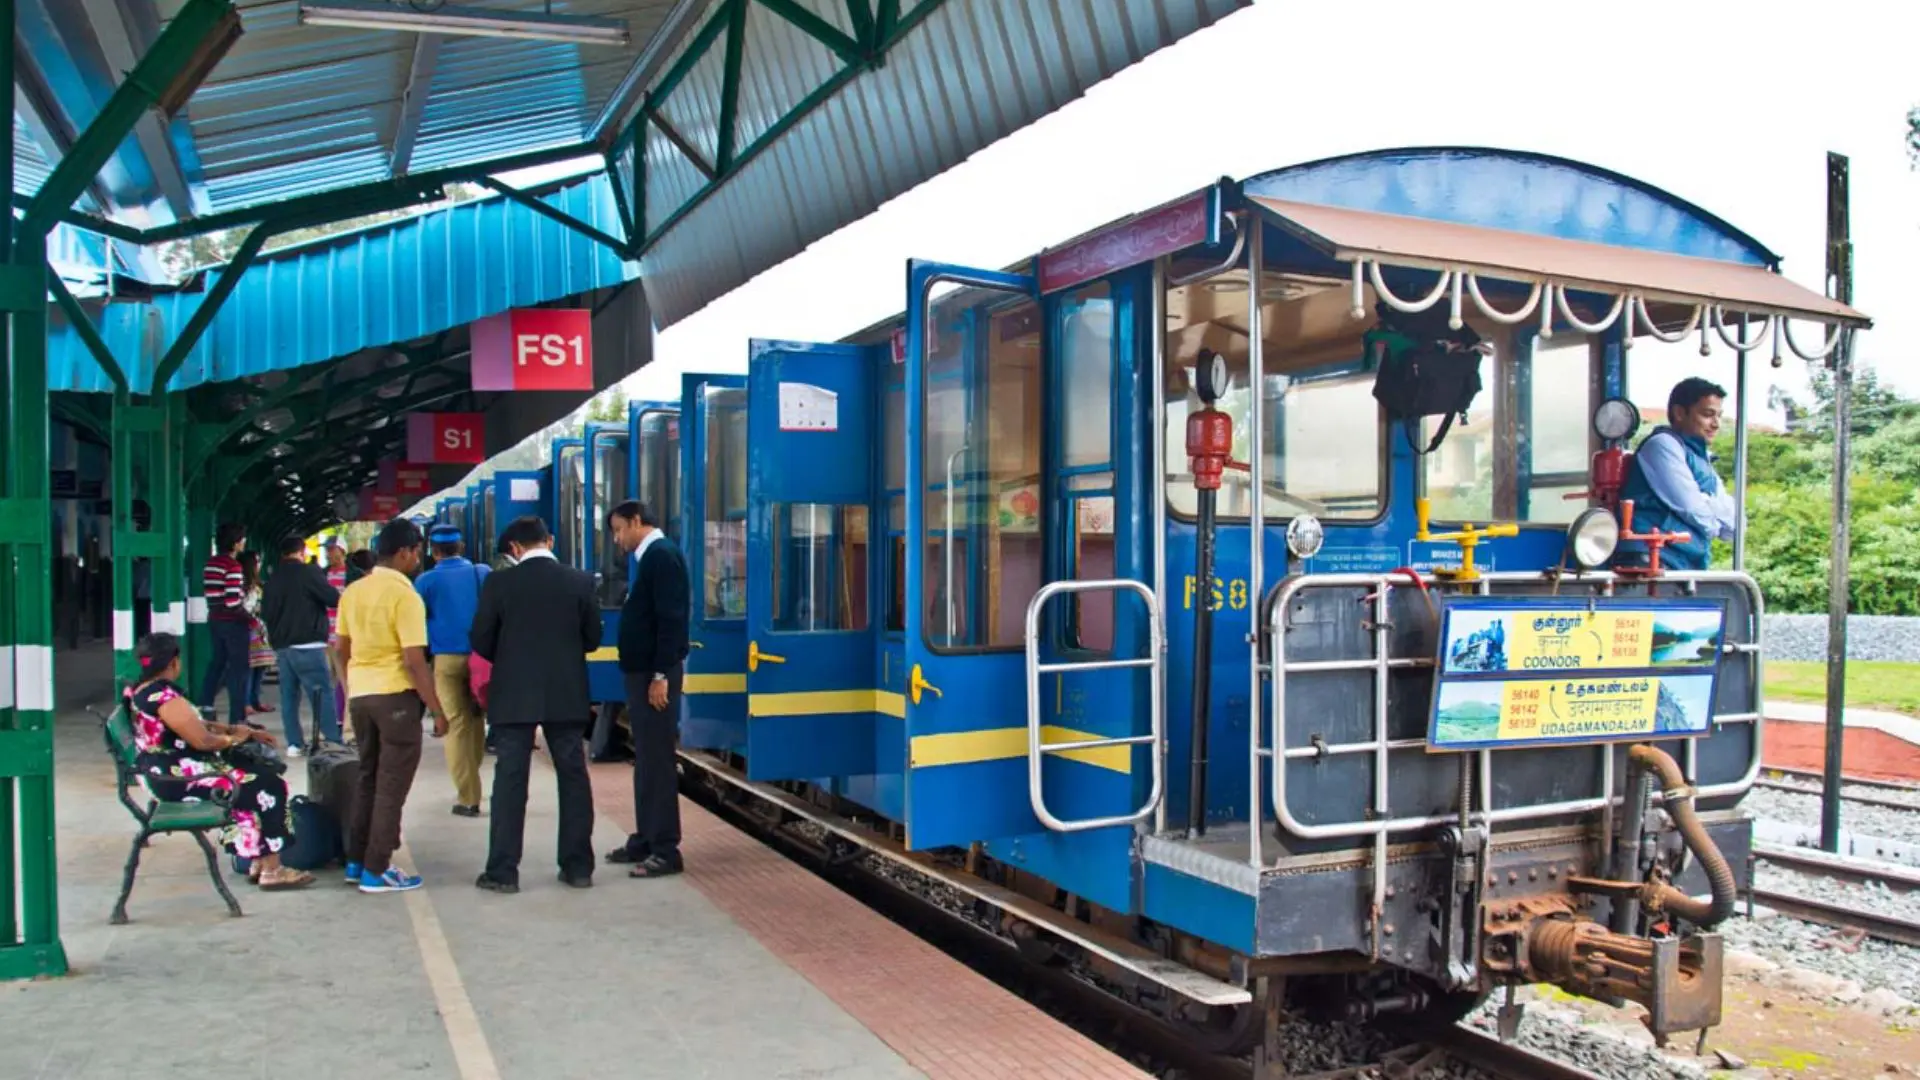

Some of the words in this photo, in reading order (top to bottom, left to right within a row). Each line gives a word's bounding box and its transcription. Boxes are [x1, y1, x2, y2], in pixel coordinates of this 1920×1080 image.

[517, 334, 583, 366] FS1
[444, 428, 472, 449] S1
[1523, 655, 1581, 668] COONOOR
[1541, 719, 1648, 735] UDAGAMANDALAM
